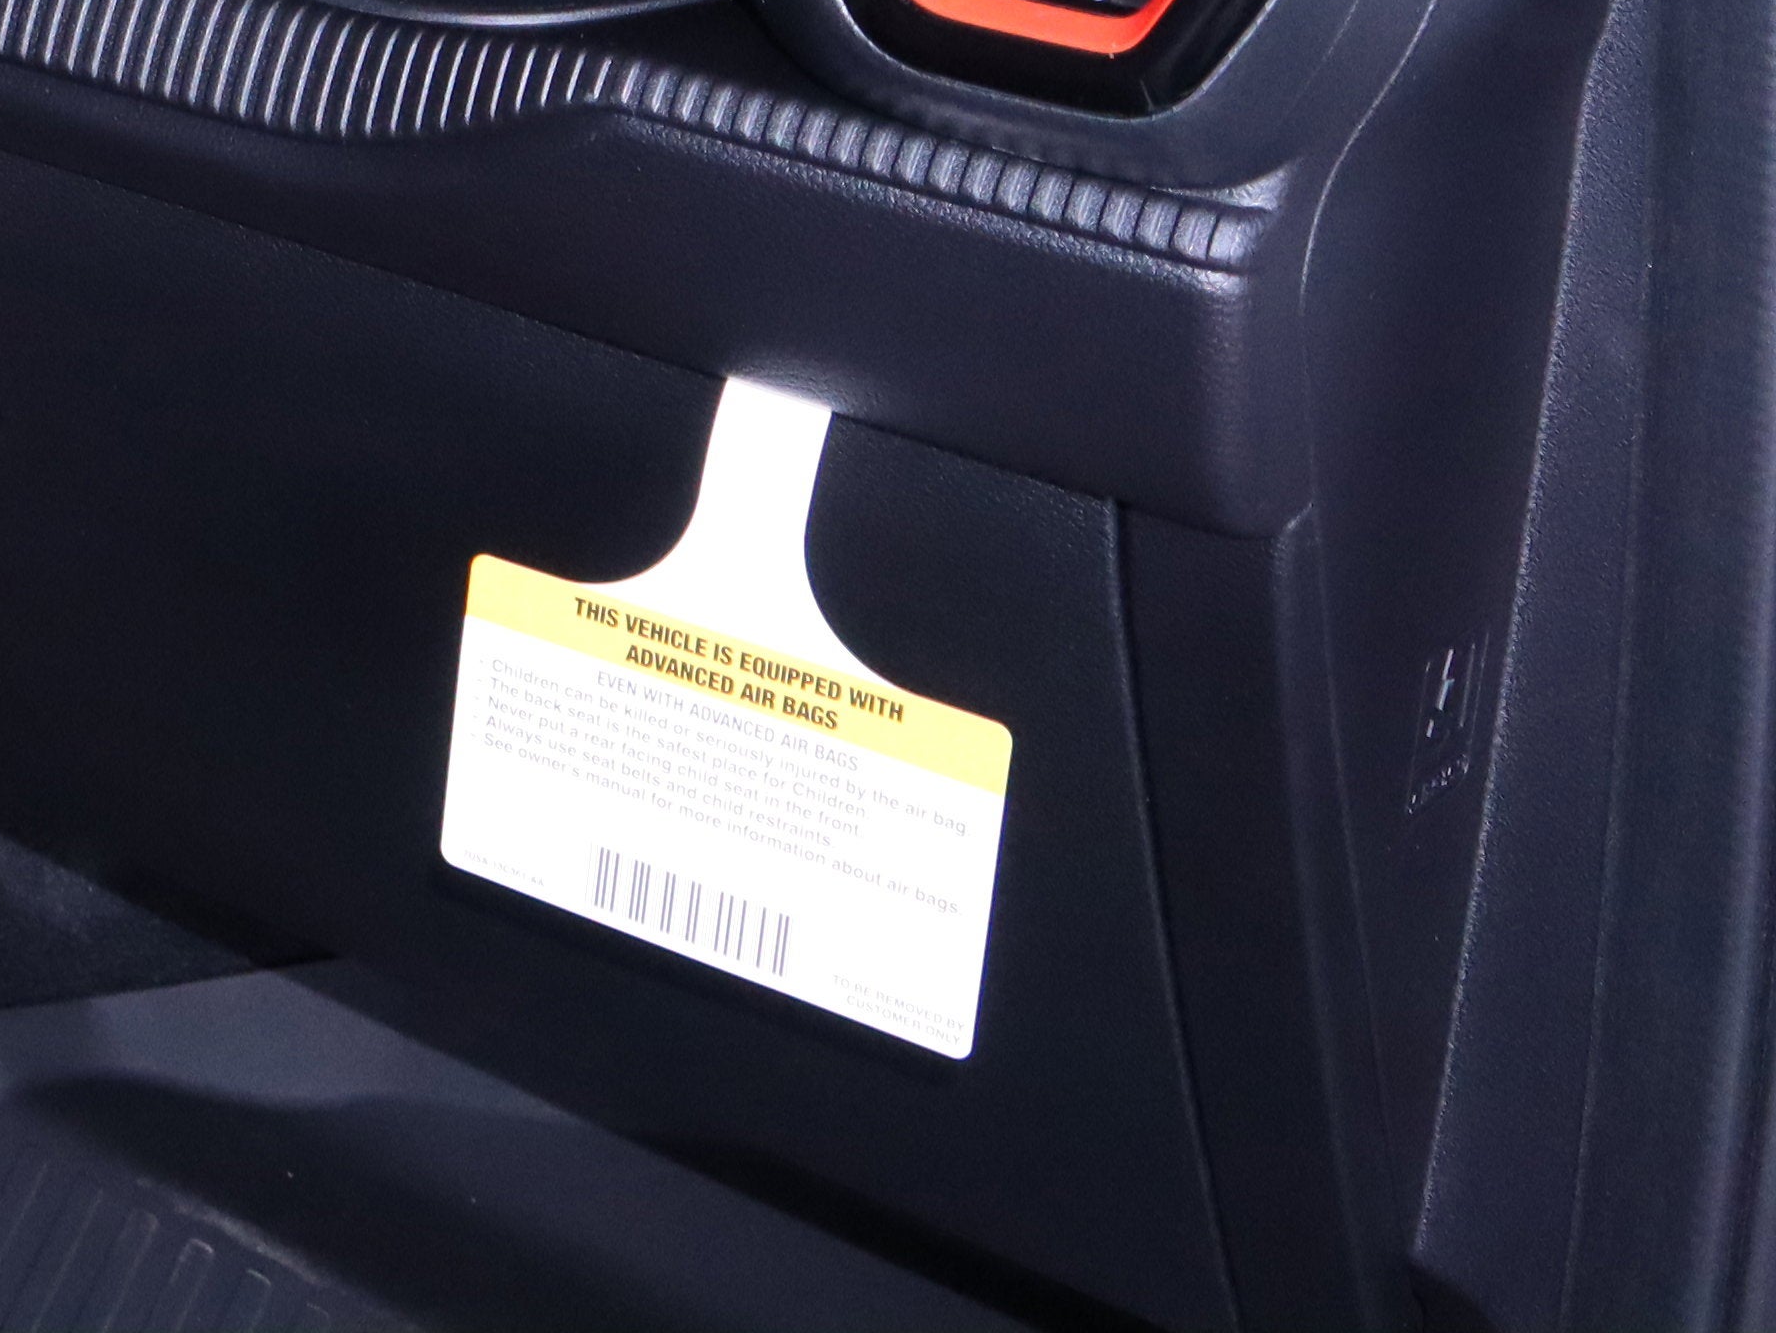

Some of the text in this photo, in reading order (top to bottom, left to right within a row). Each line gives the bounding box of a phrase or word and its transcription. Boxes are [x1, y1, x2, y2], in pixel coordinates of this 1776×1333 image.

[574, 596, 904, 722] THIS VEHICLE IS EQUIPPED WITH
[625, 643, 838, 731] ADVANCED AIR BAGS
[486, 714, 542, 747] Always
[548, 738, 575, 757] use
[582, 748, 615, 771] seat
[621, 761, 660, 787] belts
[666, 777, 696, 800] and
[702, 790, 743, 817] child
[488, 695, 532, 722] Never
[538, 714, 564, 736] put
[569, 726, 578, 738] a
[584, 731, 615, 751] rear
[621, 742, 671, 774] facing
[677, 762, 718, 787] child
[724, 779, 759, 802] seat
[764, 792, 779, 809] in
[785, 799, 812, 820] the
[489, 676, 518, 698] The
[524, 688, 562, 713] back
[567, 704, 601, 727] seat
[606, 717, 619, 733] is
[625, 724, 650, 744] the
[657, 734, 706, 763] safest
[712, 754, 757, 783] place
[763, 771, 786, 790] for
[491, 658, 559, 692] Children
[564, 684, 592, 704] can
[599, 696, 618, 712] be
[624, 704, 667, 729] killed
[673, 722, 690, 737] or
[695, 730, 772, 768] seriously
[779, 758, 839, 792] injured
[845, 780, 865, 801] by
[872, 789, 899, 810] the
[904, 801, 927, 820] air
[597, 671, 858, 772] EVEN WITH ADVANCED AIR BAGS
[484, 732, 512, 754] See
[518, 746, 580, 778] owners
[585, 769, 645, 801] manual
[651, 792, 674, 811] for
[679, 803, 721, 829] more
[727, 819, 825, 866] information
[831, 857, 880, 886] about
[887, 877, 910, 896] air
[846, 993, 960, 1046] CUSTOMER ONLY
